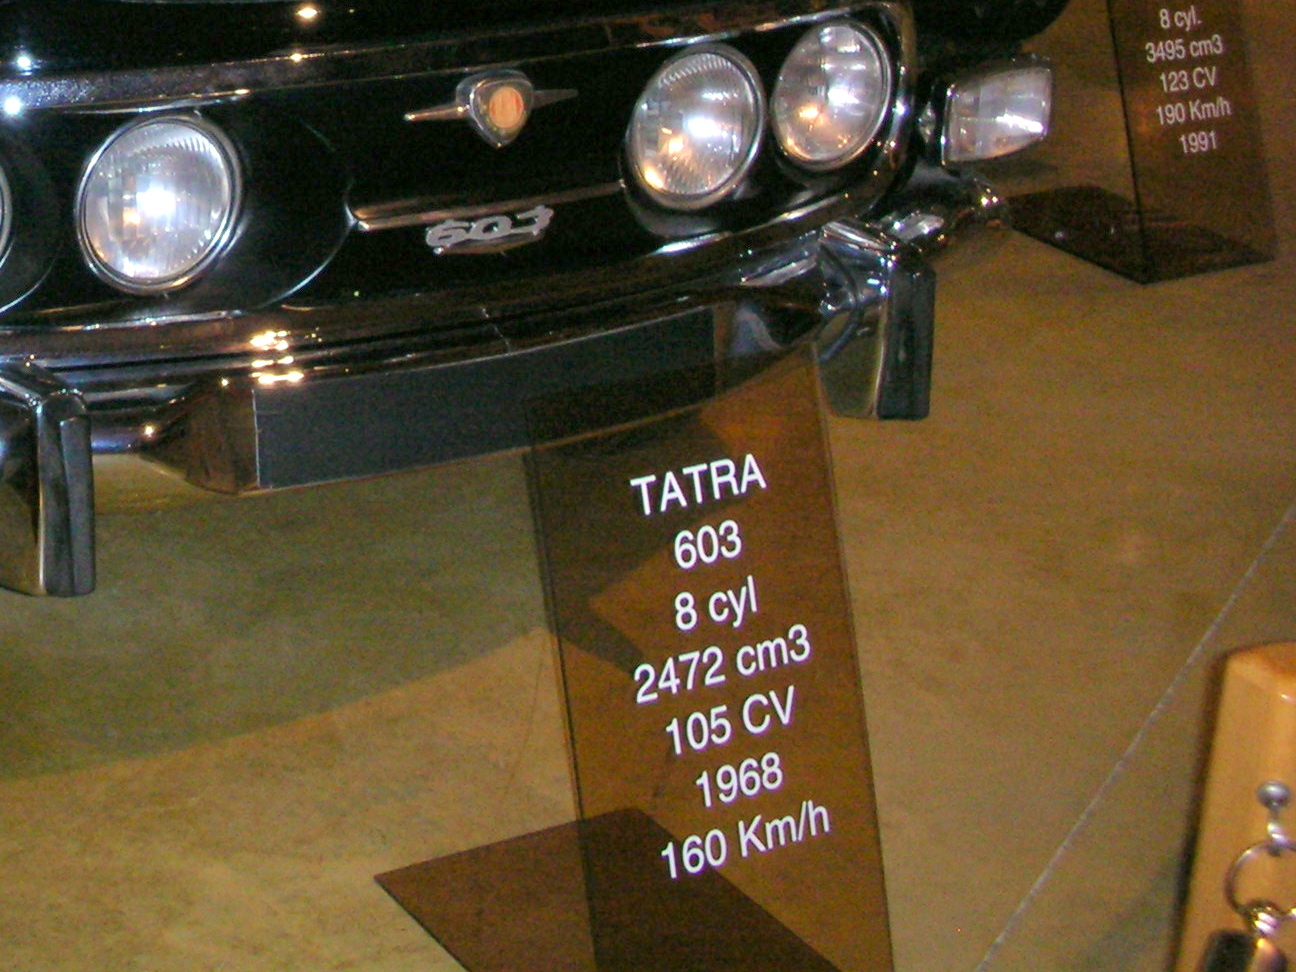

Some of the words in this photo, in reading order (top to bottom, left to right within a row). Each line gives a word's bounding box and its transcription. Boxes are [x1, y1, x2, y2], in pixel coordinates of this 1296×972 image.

[1159, 8, 1171, 29] 8
[1174, 5, 1201, 32] cyl.
[1145, 38, 1186, 63] 3495
[1189, 34, 1223, 57] cm3
[1160, 70, 1189, 92] 123
[1192, 66, 1216, 89] CV
[1156, 102, 1186, 125] 190
[1189, 96, 1231, 121] Km/h
[1180, 130, 1216, 153] 1991
[425, 205, 555, 248] 603
[629, 453, 767, 516] TATRA
[674, 519, 742, 569] 603
[674, 591, 698, 631] 8
[708, 575, 758, 628] cyl
[634, 645, 726, 704] 2472
[735, 623, 811, 676] cm3
[665, 704, 732, 755] 105
[742, 685, 795, 734] CV
[696, 752, 783, 808] 1968
[661, 829, 727, 879] 160
[738, 800, 830, 858] Km/h
